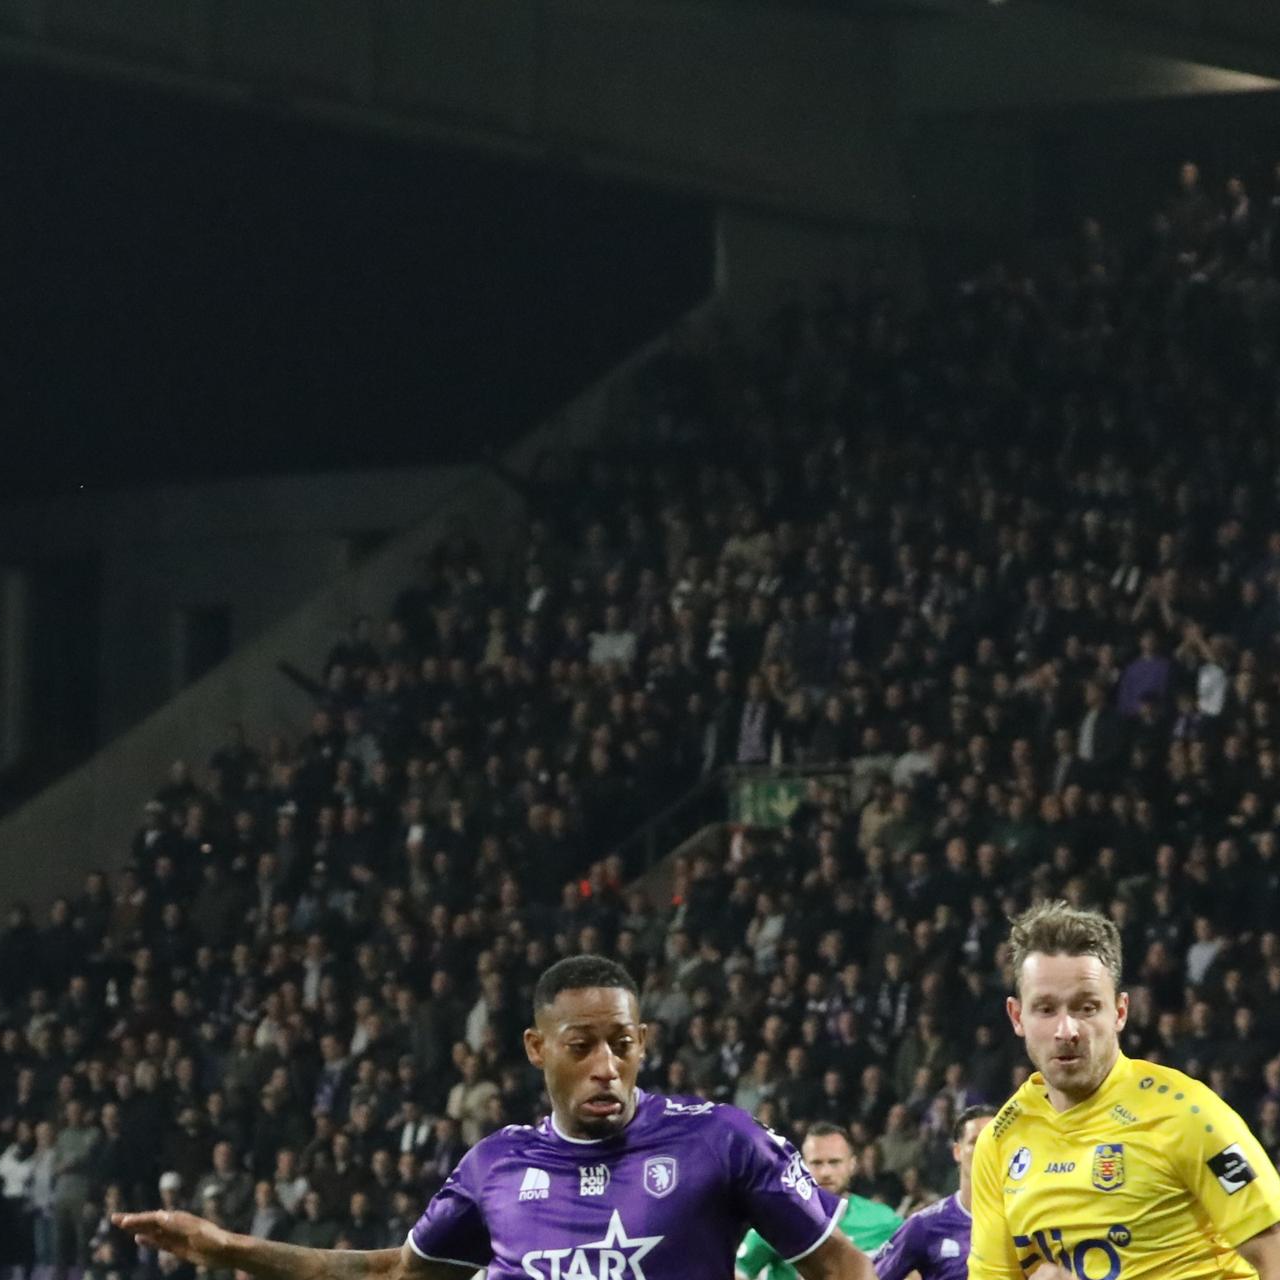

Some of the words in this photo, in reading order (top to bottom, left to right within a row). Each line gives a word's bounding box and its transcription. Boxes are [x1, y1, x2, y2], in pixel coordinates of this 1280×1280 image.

[1044, 1161, 1075, 1173] JAKO
[580, 1176, 604, 1187] POU
[519, 1189, 549, 1200] nova
[580, 1186, 605, 1196] DOU
